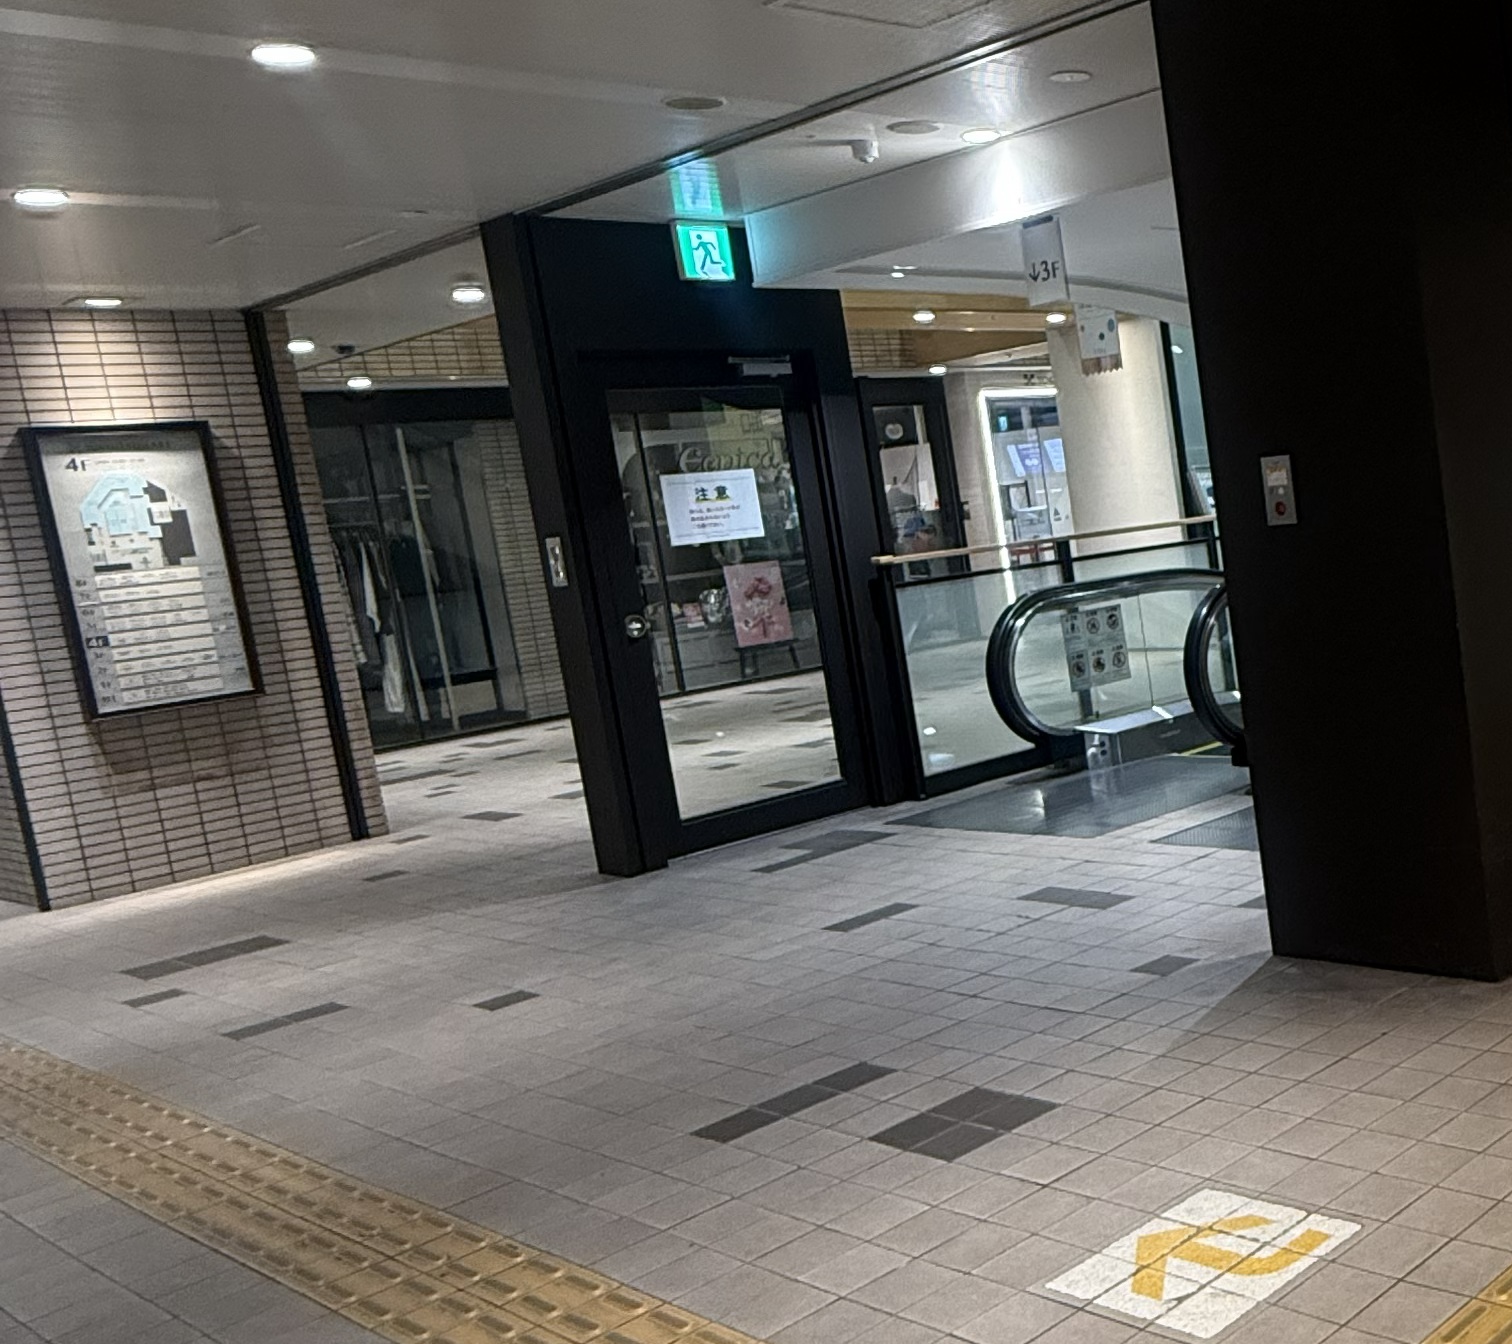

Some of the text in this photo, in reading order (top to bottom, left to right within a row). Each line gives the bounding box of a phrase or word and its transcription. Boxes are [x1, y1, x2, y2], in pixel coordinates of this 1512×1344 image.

[1041, 260, 1060, 282] 3F
[65, 457, 91, 472] 4F
[695, 485, 731, 502] 注意
